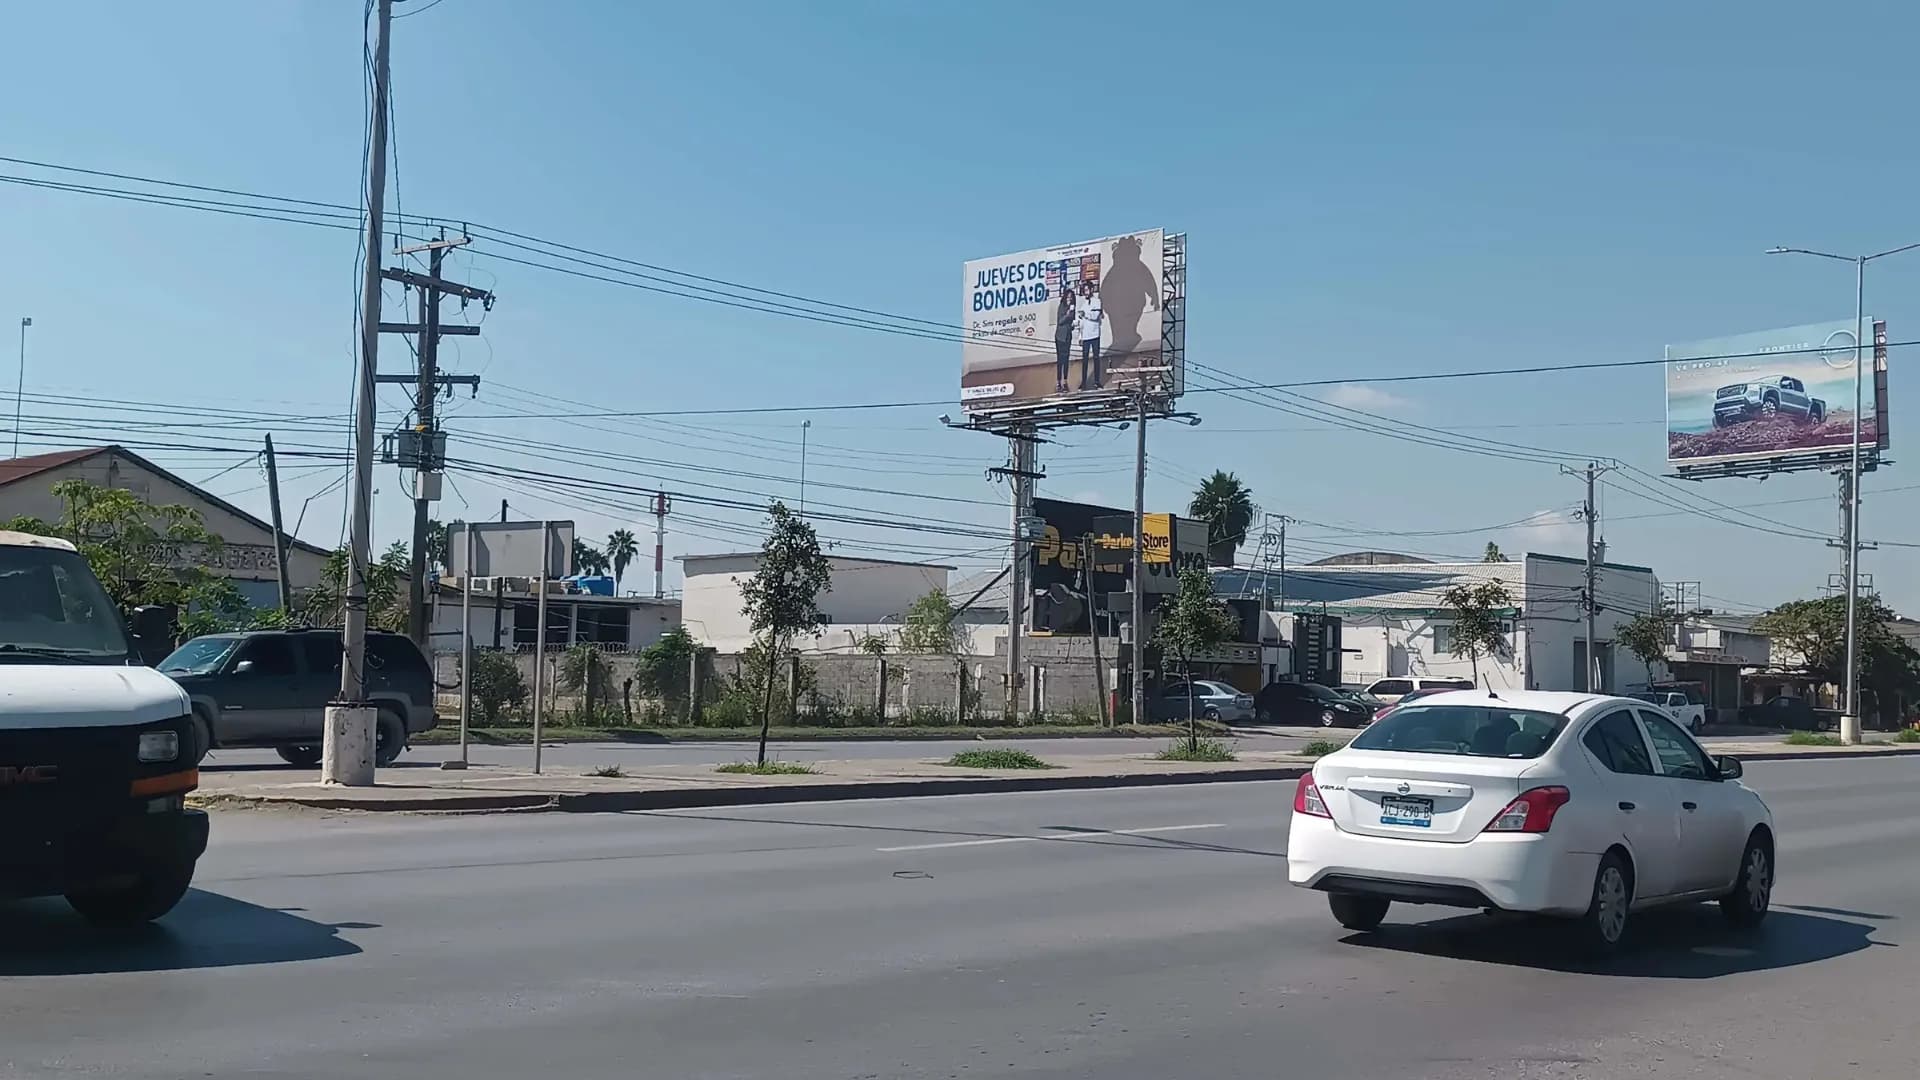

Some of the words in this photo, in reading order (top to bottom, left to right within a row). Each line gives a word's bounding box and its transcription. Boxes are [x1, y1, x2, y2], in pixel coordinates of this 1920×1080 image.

[973, 264, 1025, 289] JUEVES
[1027, 259, 1046, 279] DE
[995, 314, 1017, 327] regala
[1142, 532, 1169, 549] Store
